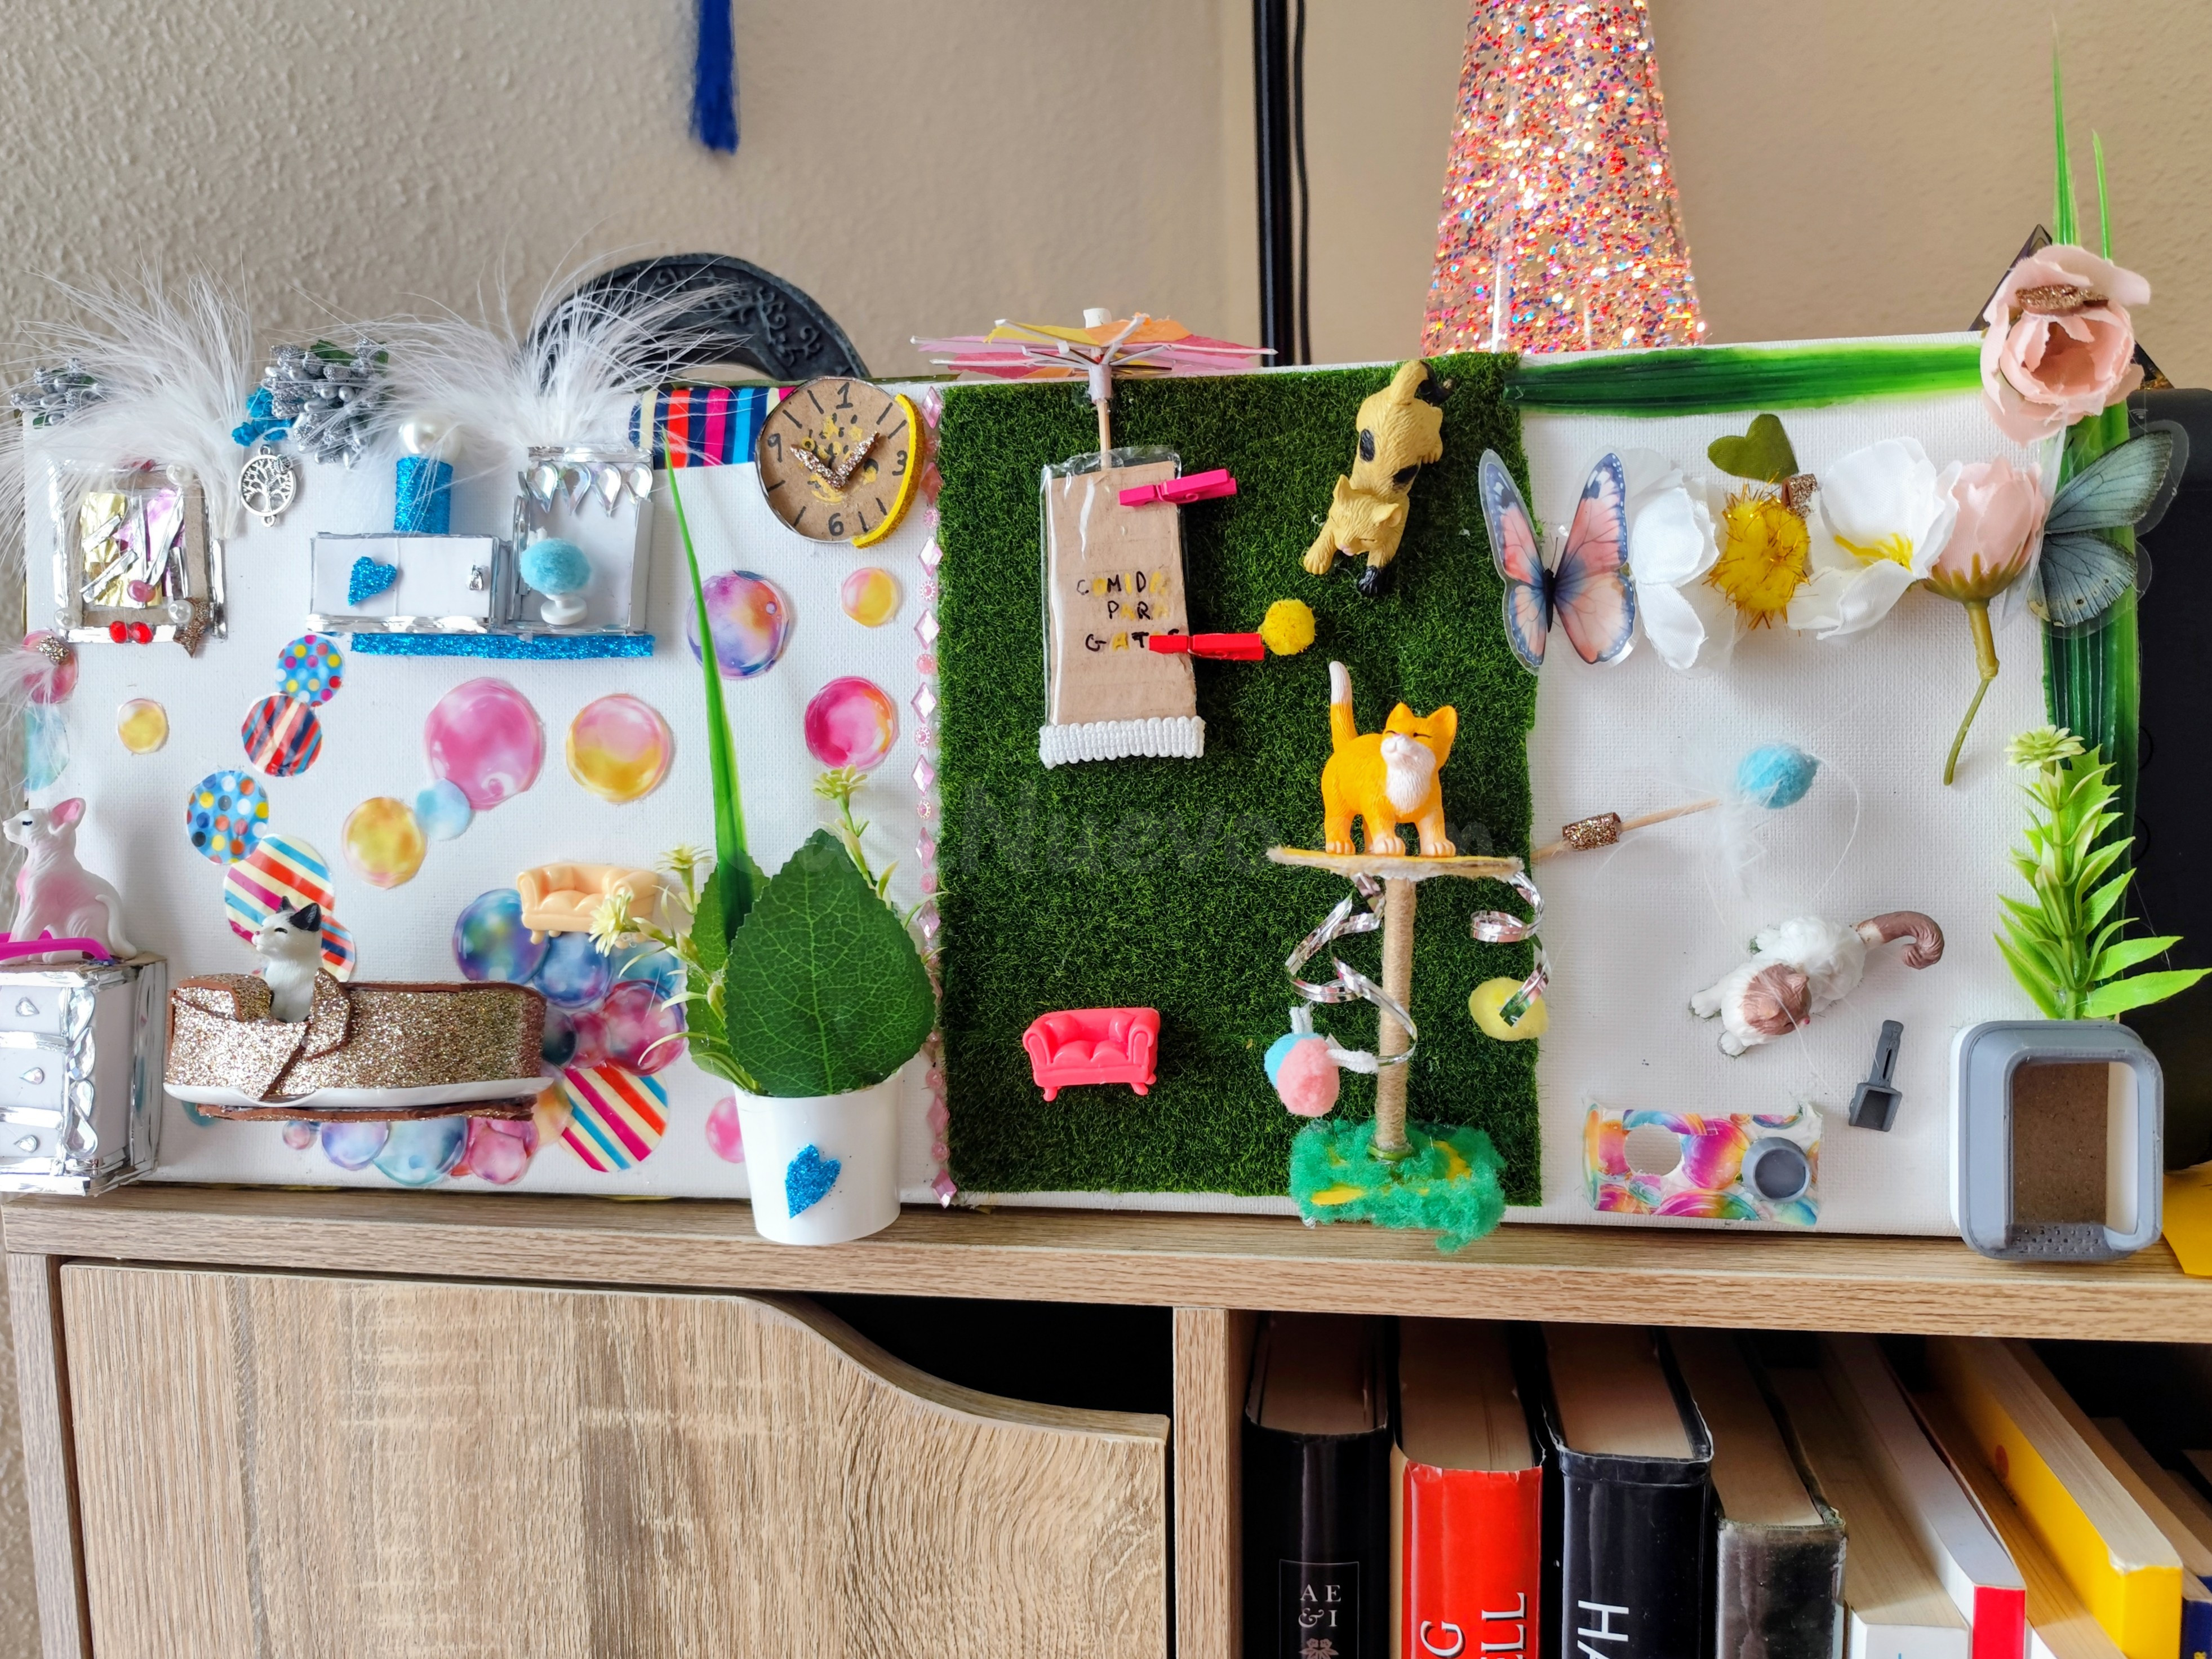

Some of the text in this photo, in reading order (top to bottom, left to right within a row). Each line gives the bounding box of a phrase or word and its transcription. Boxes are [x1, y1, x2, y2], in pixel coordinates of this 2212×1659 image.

[767, 433, 783, 463] 9
[892, 450, 908, 476] 3
[828, 512, 845, 536] 6
[1085, 628, 1180, 652] GAT
